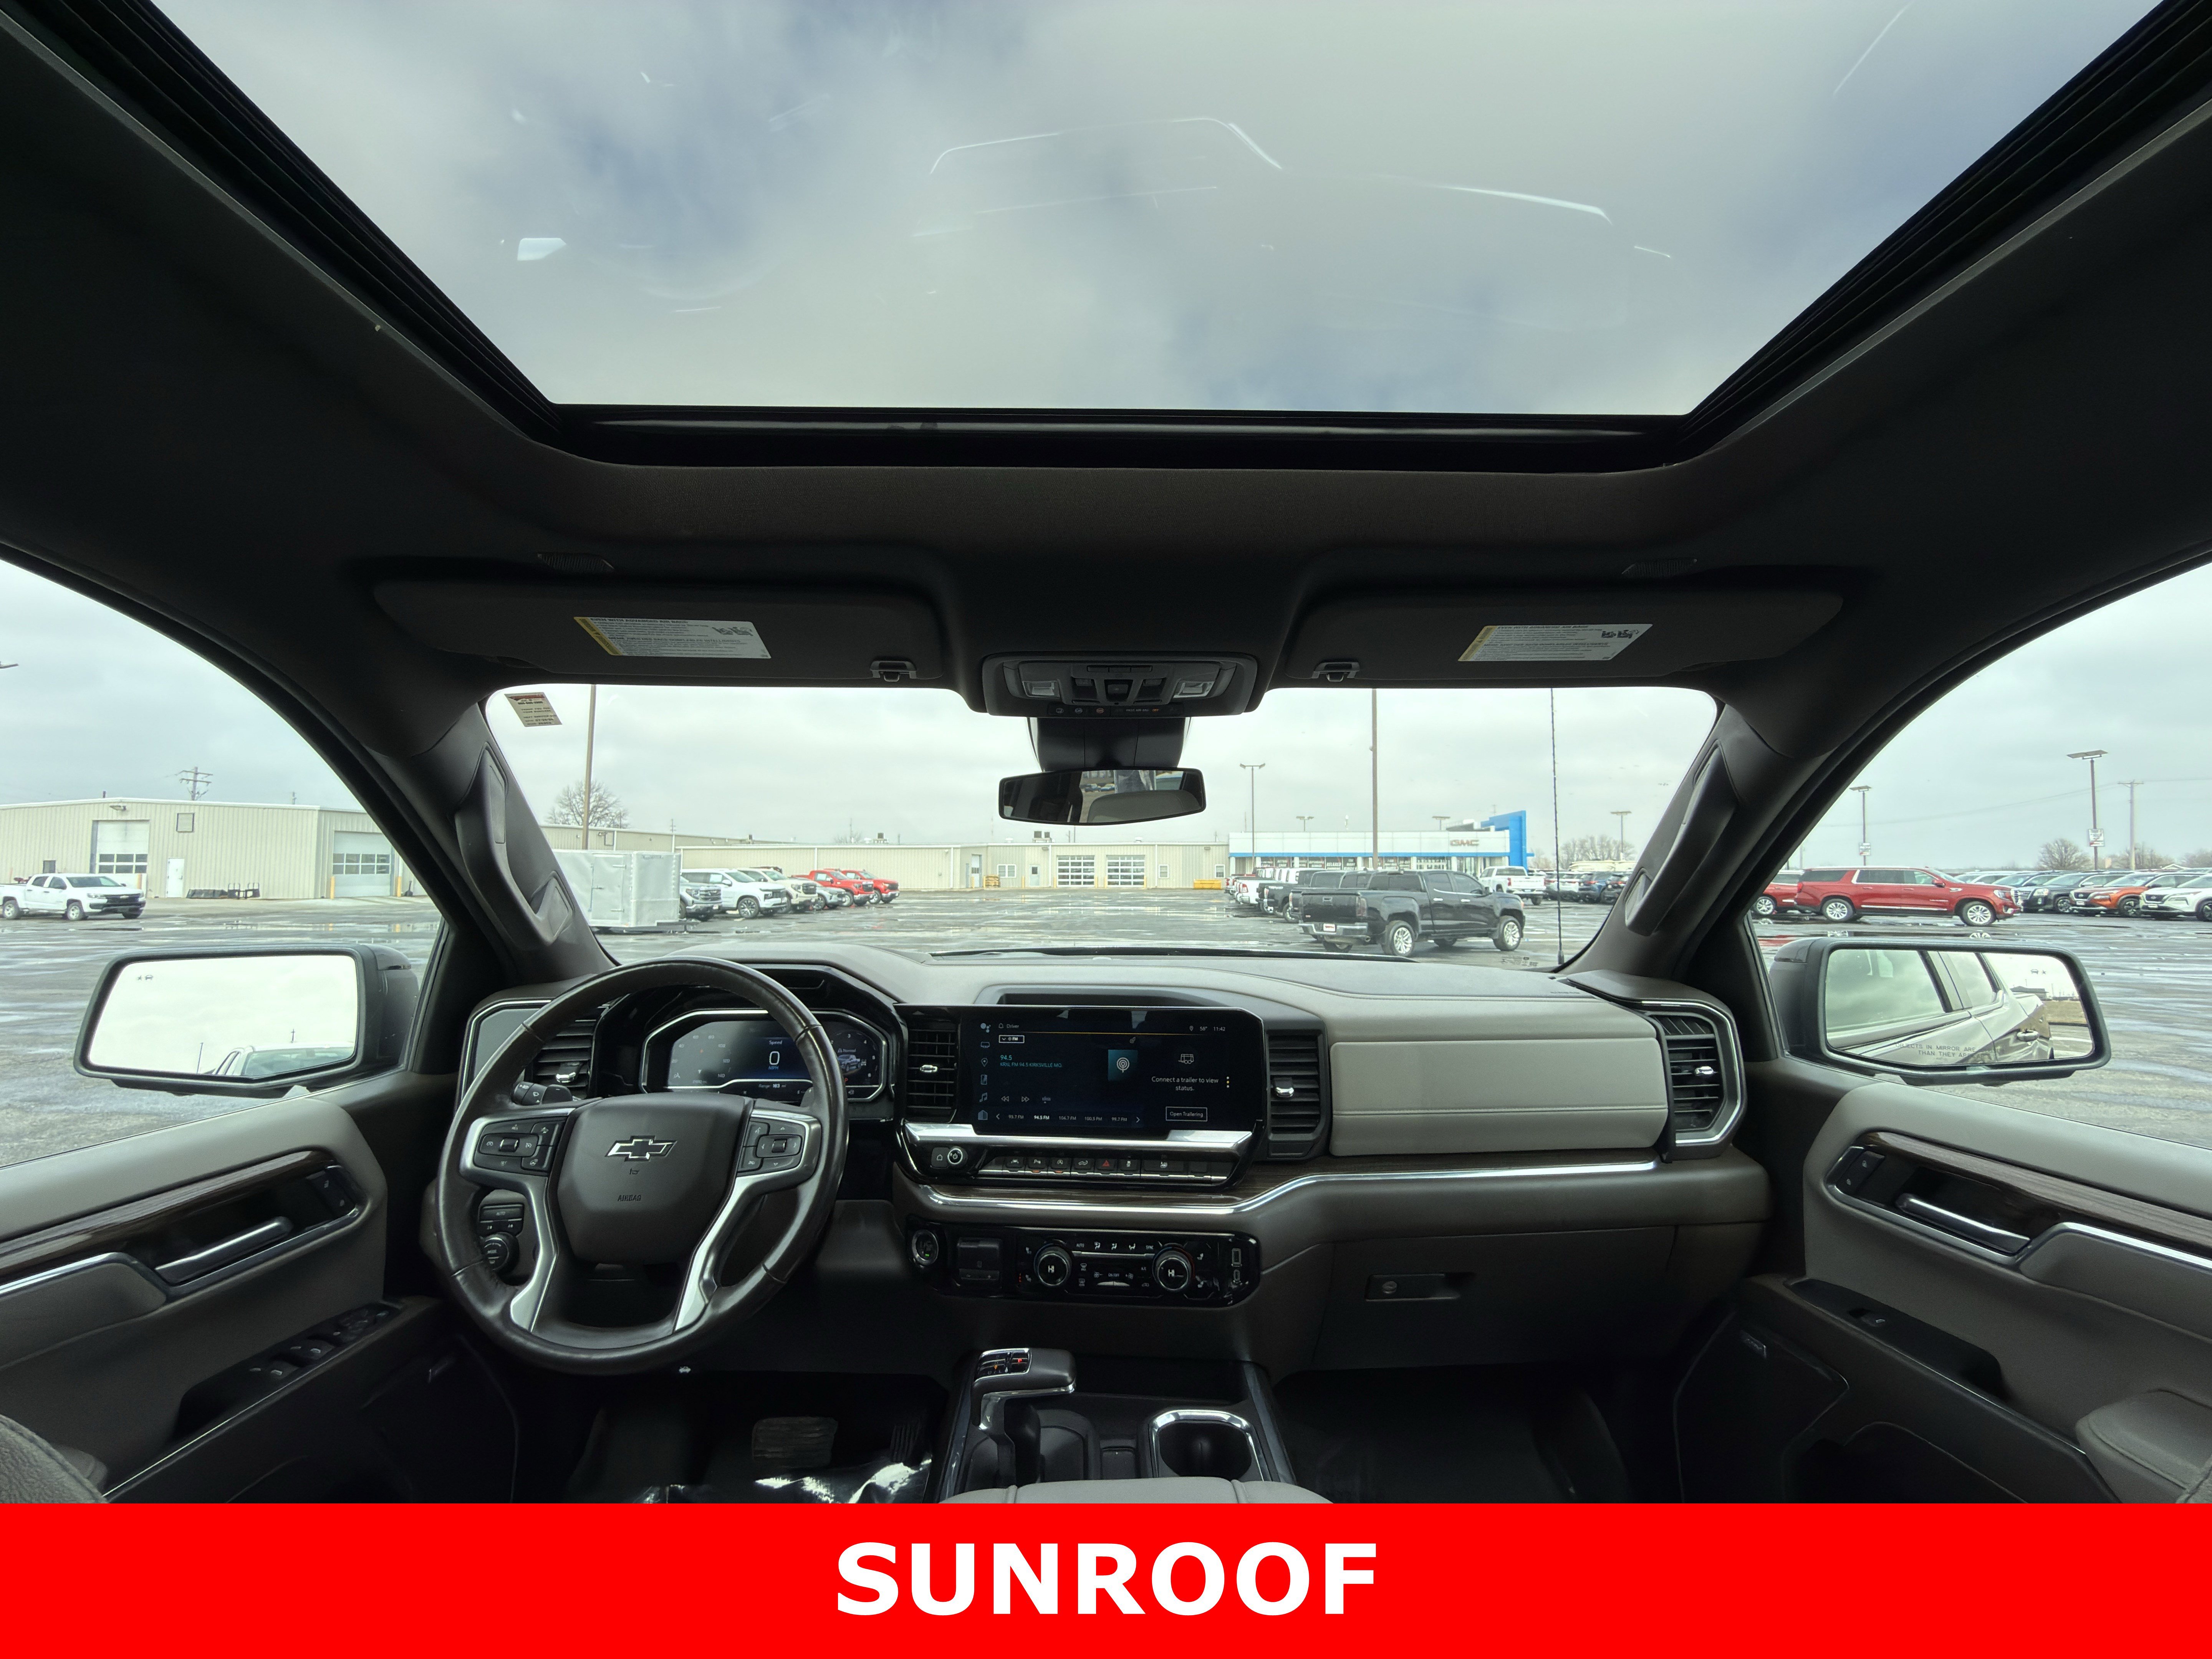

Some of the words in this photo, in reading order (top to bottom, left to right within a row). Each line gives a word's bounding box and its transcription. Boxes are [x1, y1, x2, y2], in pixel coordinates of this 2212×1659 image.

[769, 1051, 780, 1065] 0
[1048, 1265, 1055, 1273] HI
[1168, 1269, 1175, 1277] HI
